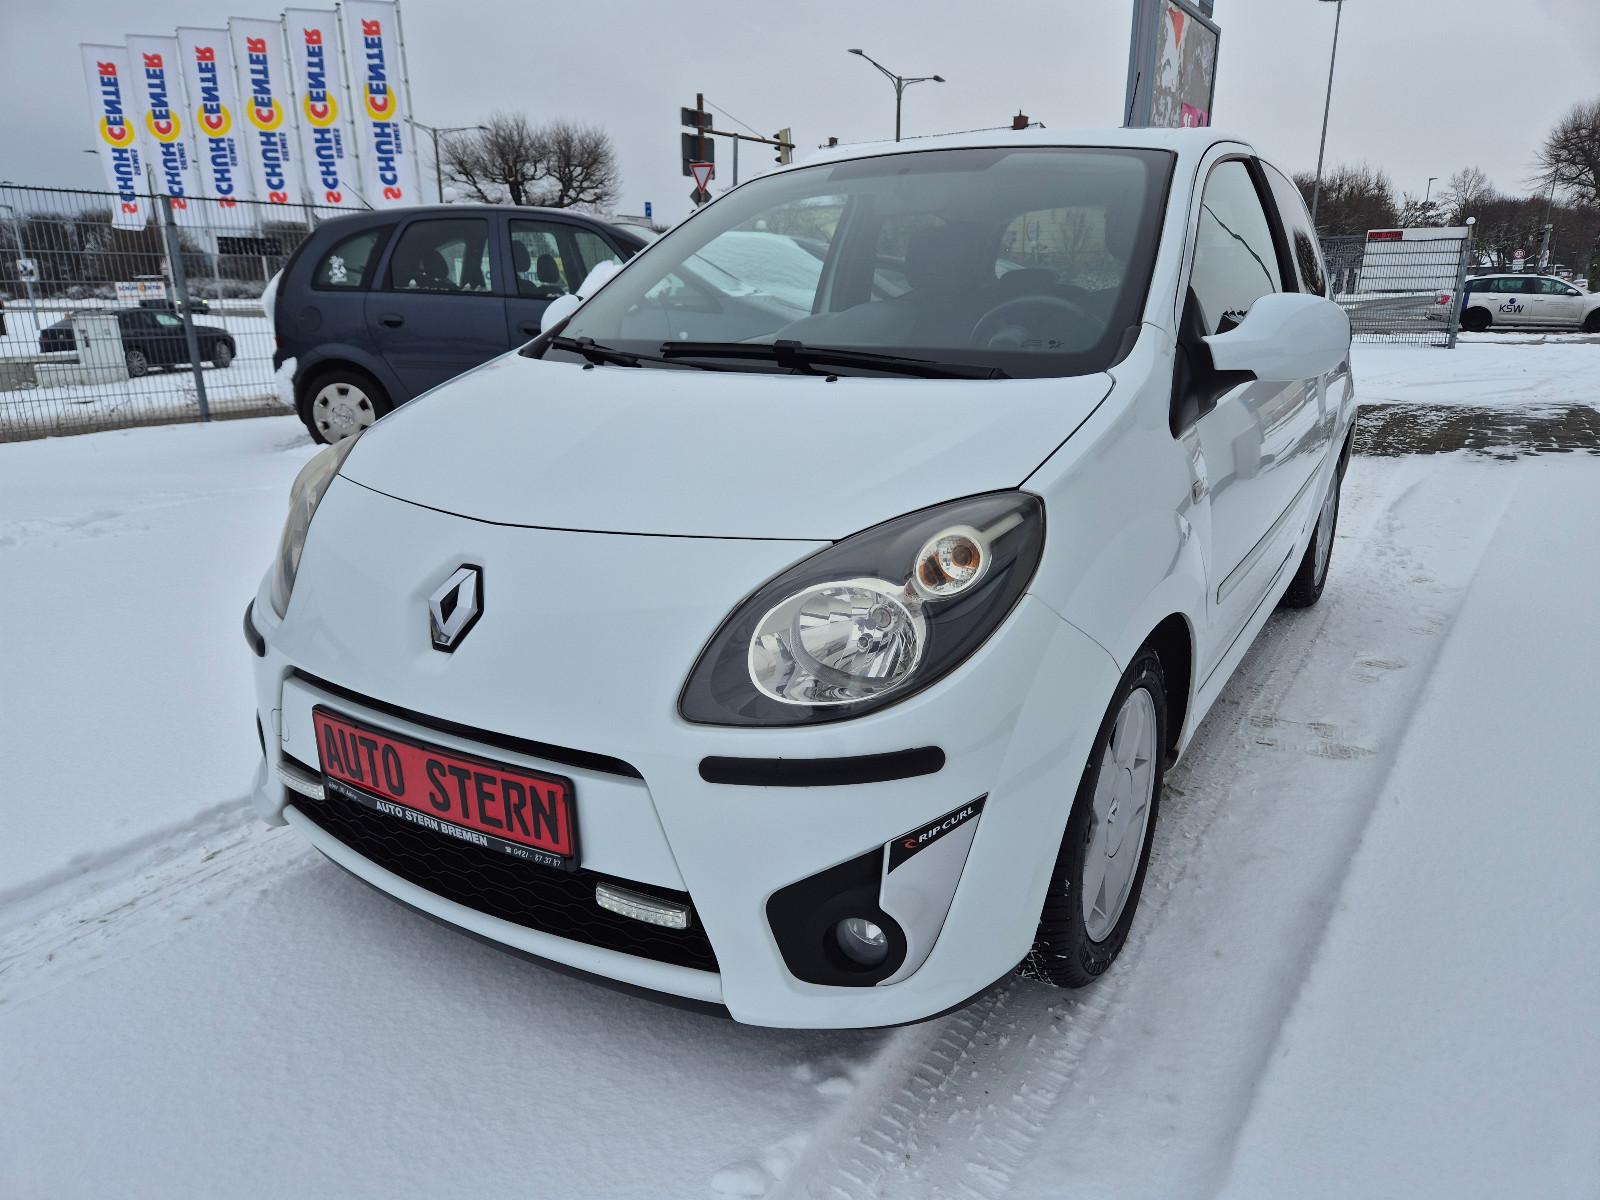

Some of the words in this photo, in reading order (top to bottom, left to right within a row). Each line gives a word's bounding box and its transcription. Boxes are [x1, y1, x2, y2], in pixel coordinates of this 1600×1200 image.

[1499, 304, 1524, 312] KSW
[323, 723, 404, 796] AUTO
[426, 758, 559, 844] STERN
[376, 801, 402, 817] AUTO
[406, 811, 438, 831] STERN
[441, 823, 488, 846] BREMEN
